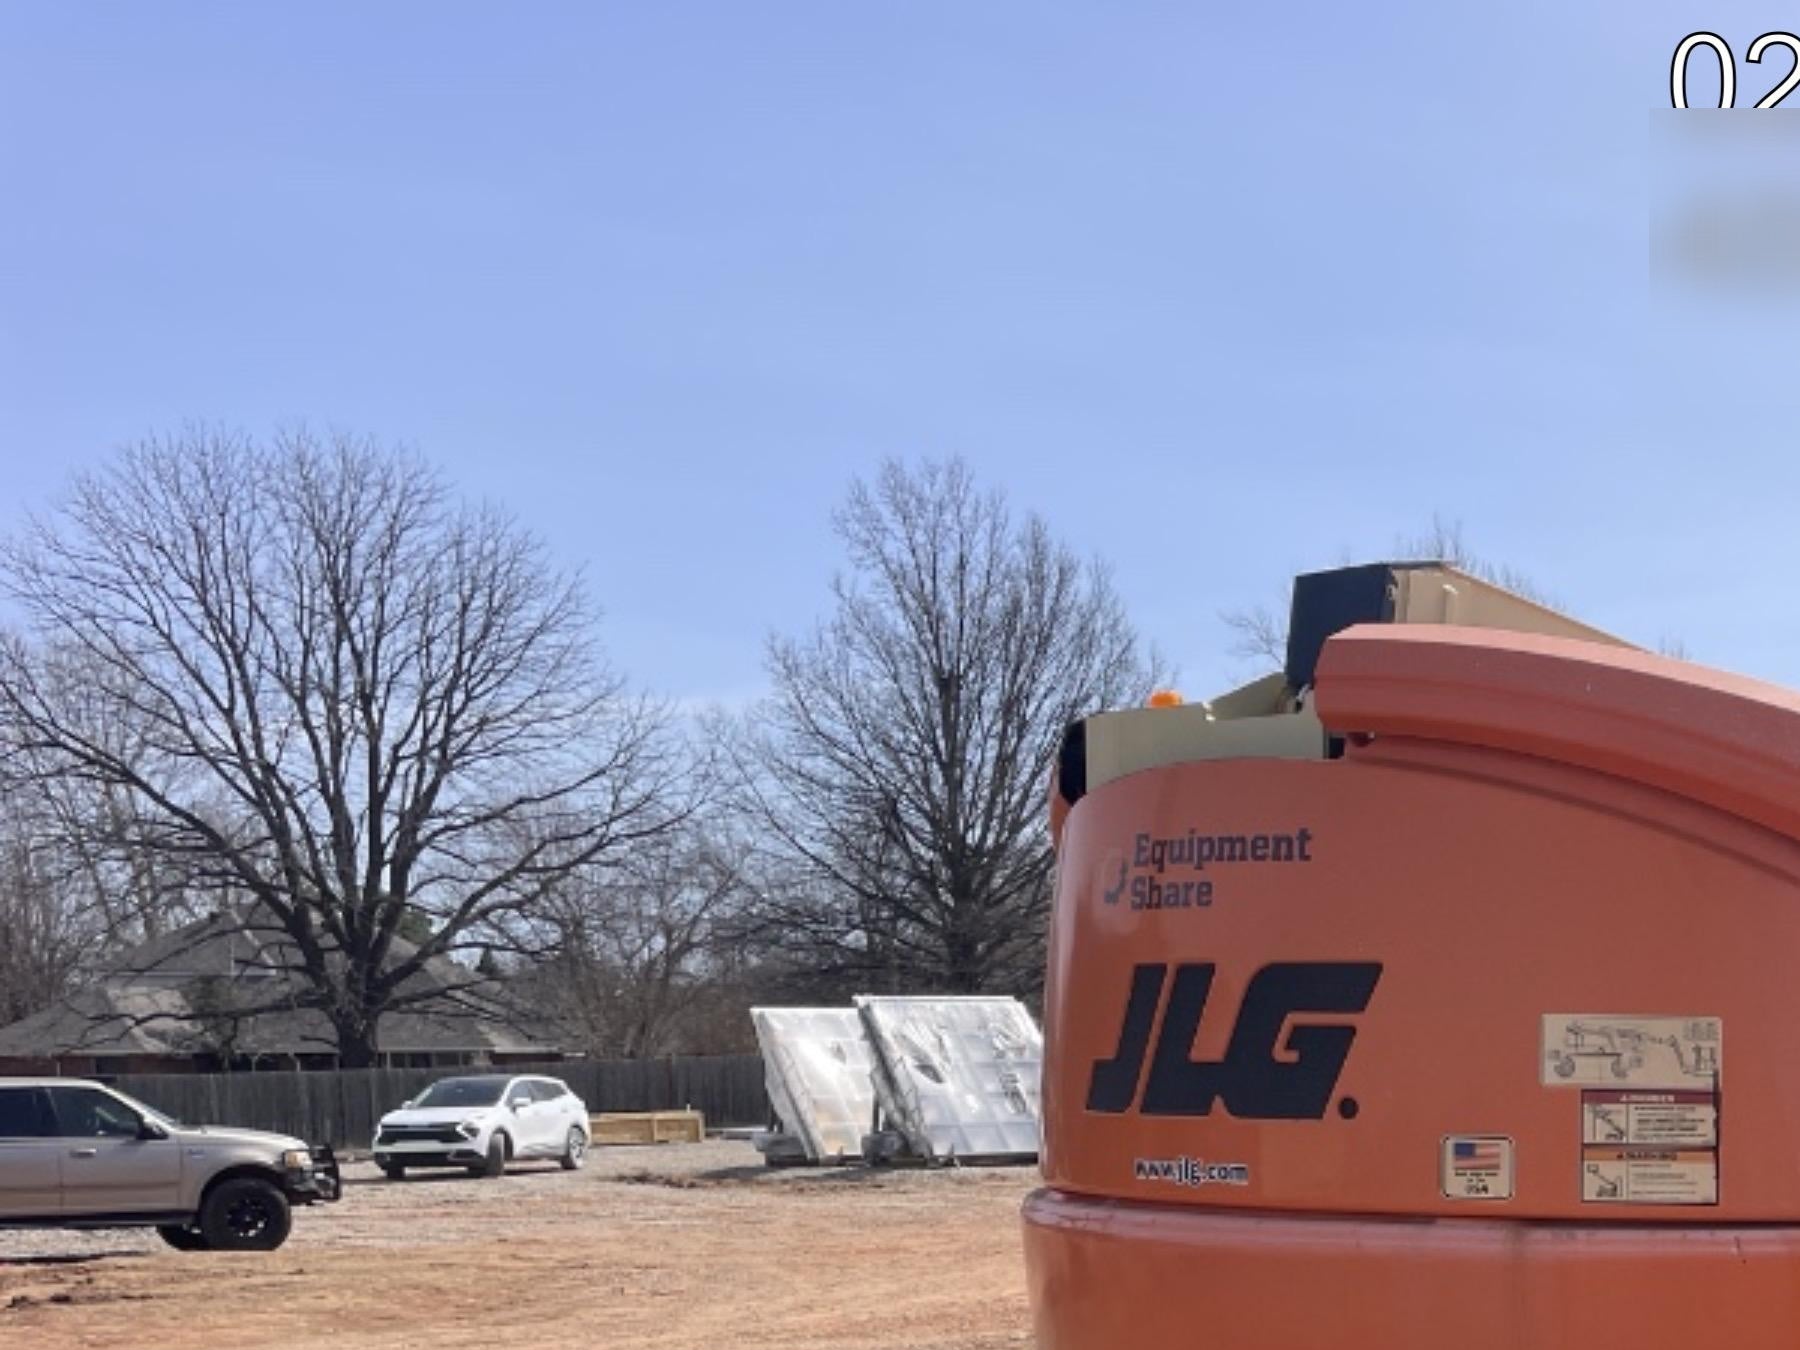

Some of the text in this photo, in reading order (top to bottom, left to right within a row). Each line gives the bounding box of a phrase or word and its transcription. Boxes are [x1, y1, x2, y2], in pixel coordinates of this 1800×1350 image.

[1133, 827, 1312, 873] Equipment
[1129, 875, 1214, 911] Share
[1135, 1157, 1248, 1185] www.jlg.com
